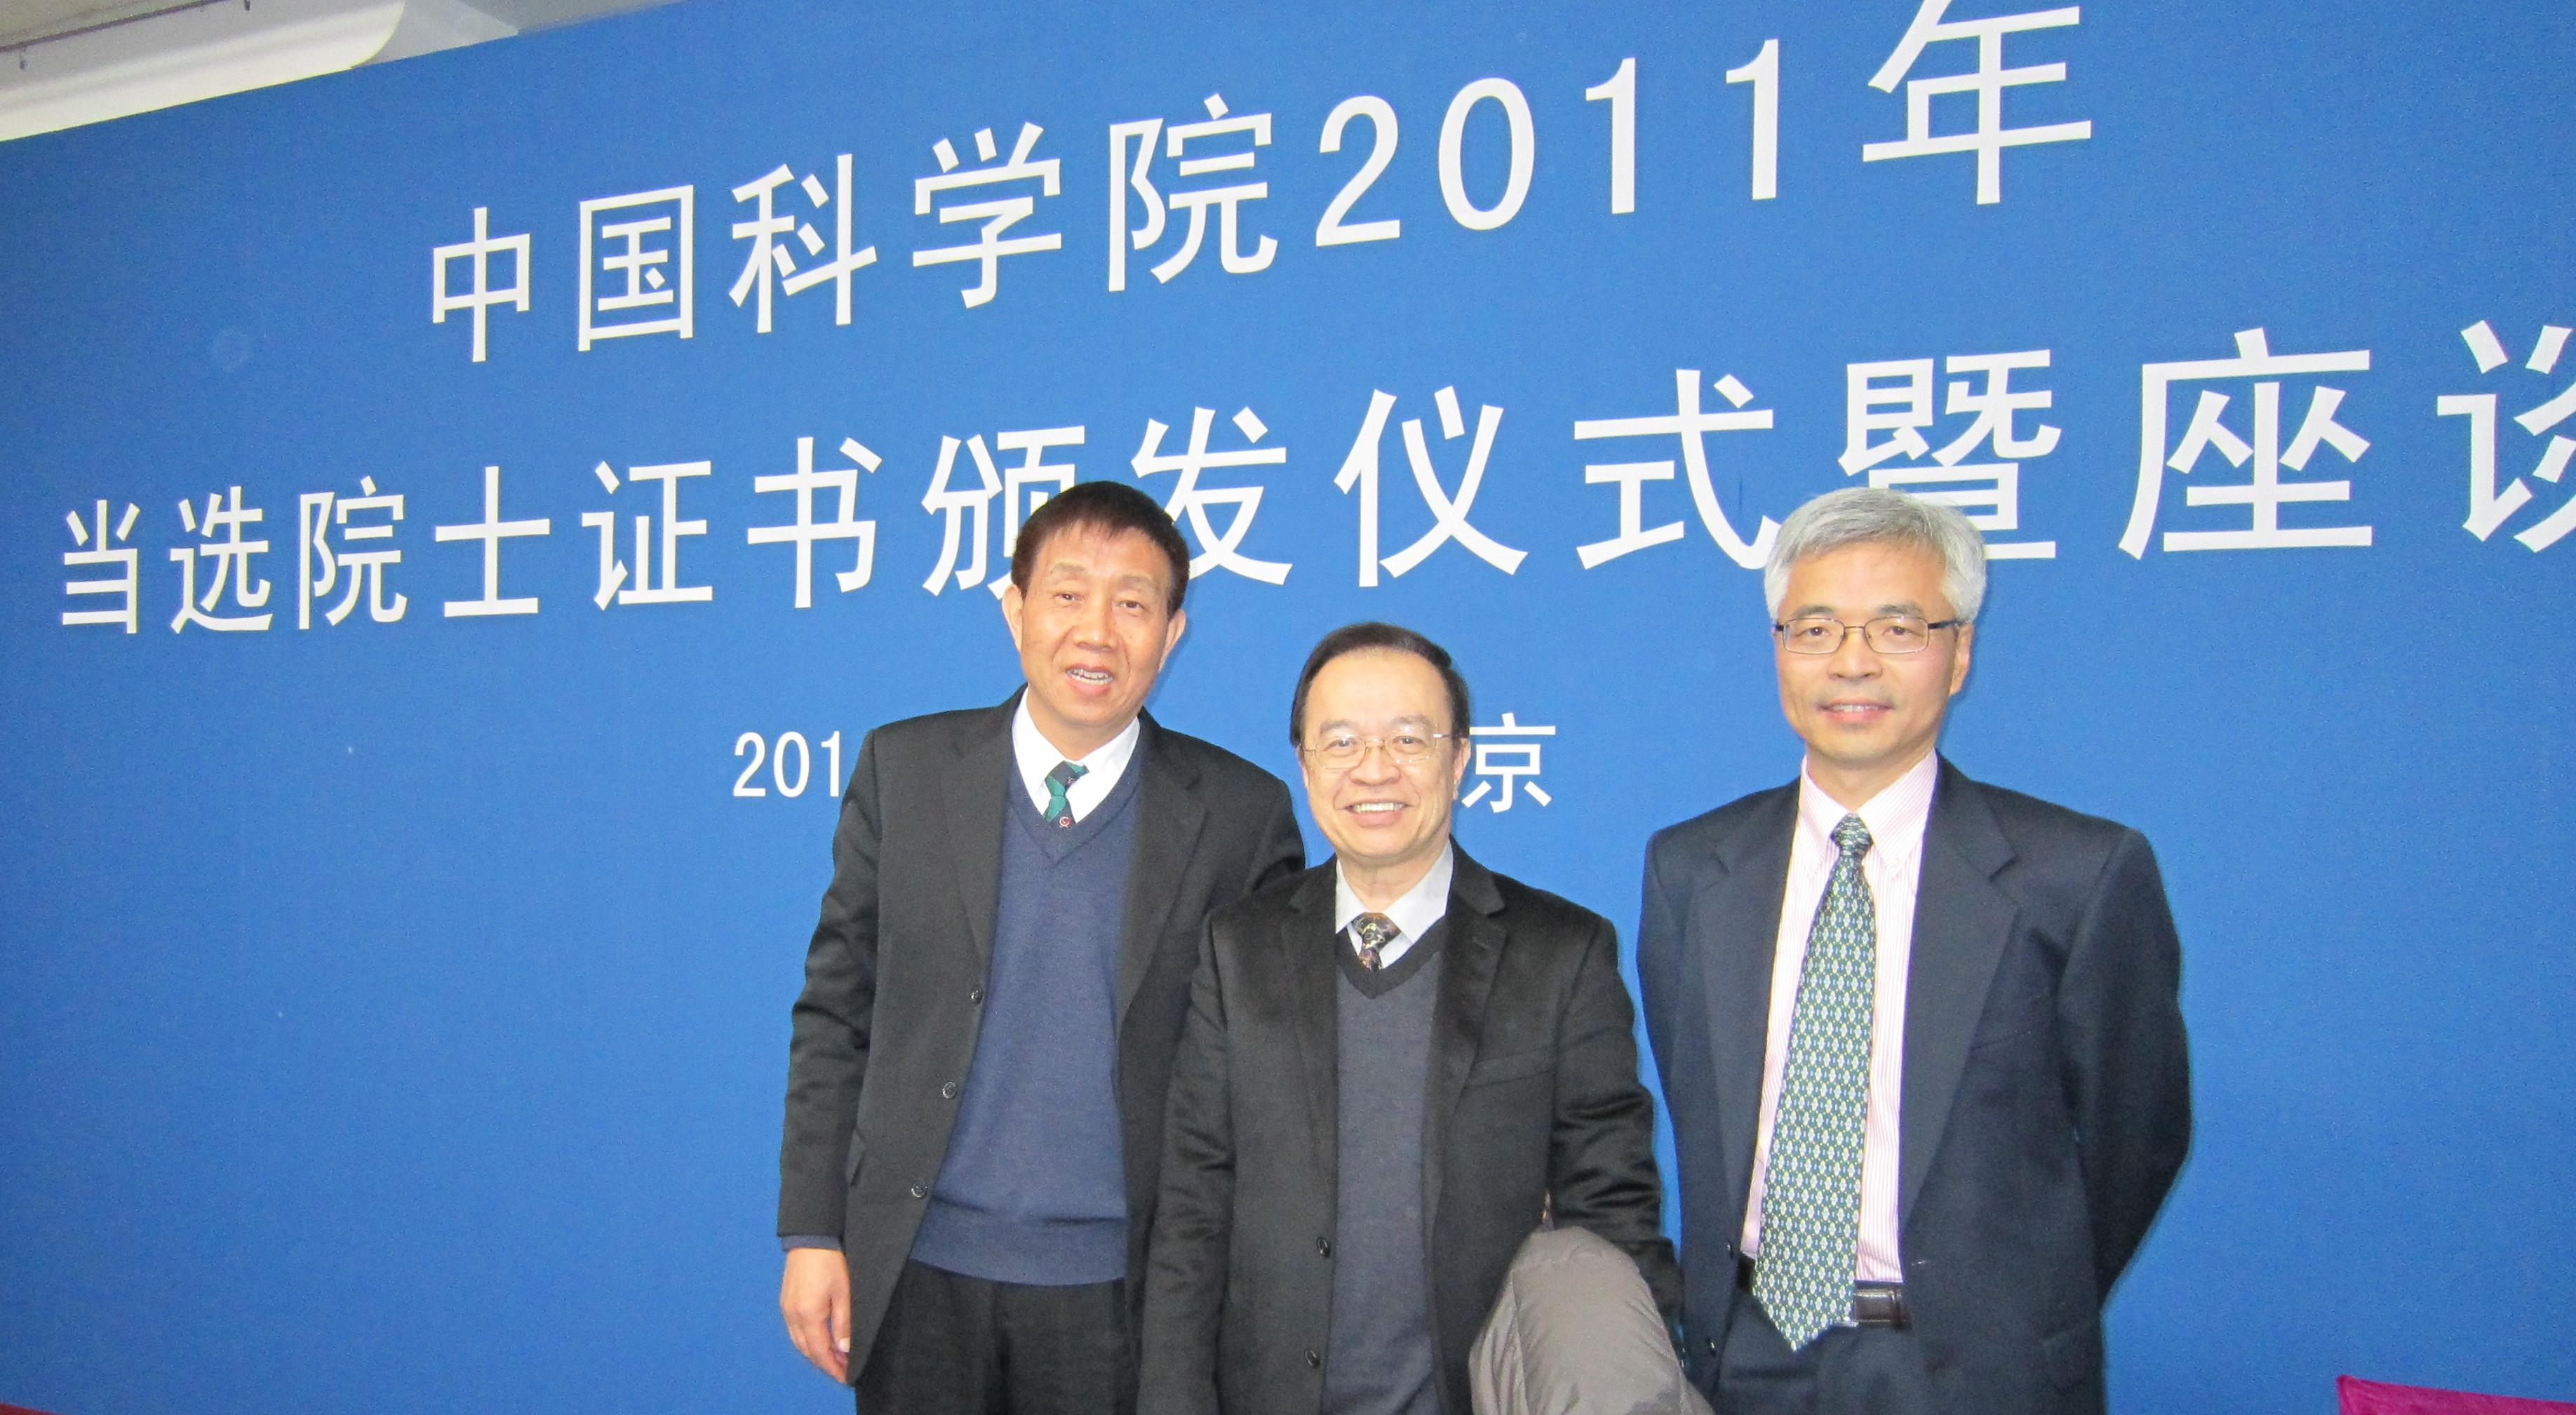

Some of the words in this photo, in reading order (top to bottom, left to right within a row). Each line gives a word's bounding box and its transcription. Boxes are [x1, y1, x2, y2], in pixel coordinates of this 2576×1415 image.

[431, 0, 2093, 363] 中国科学院2011年
[1461, 711, 1557, 814] 京
